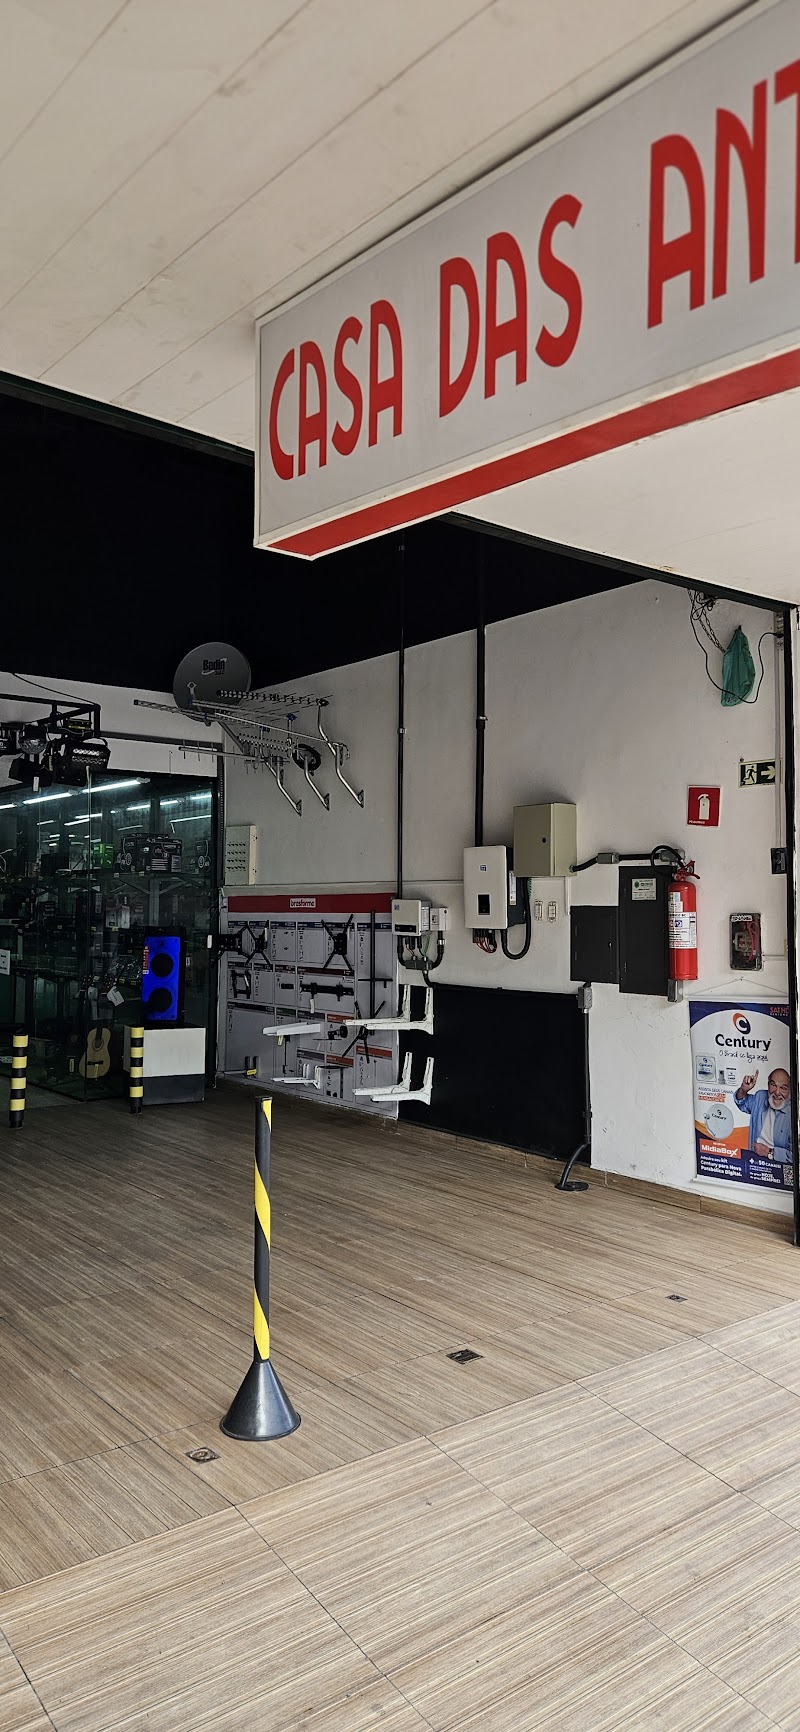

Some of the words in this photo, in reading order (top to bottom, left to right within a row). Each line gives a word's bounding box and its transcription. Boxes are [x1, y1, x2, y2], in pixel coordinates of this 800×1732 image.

[269, 299, 402, 480] CASA
[440, 194, 582, 418] DAS
[715, 1033, 771, 1051] Century
[701, 1144, 738, 1157] MidiaBox
[700, 1160, 718, 1168] Century
